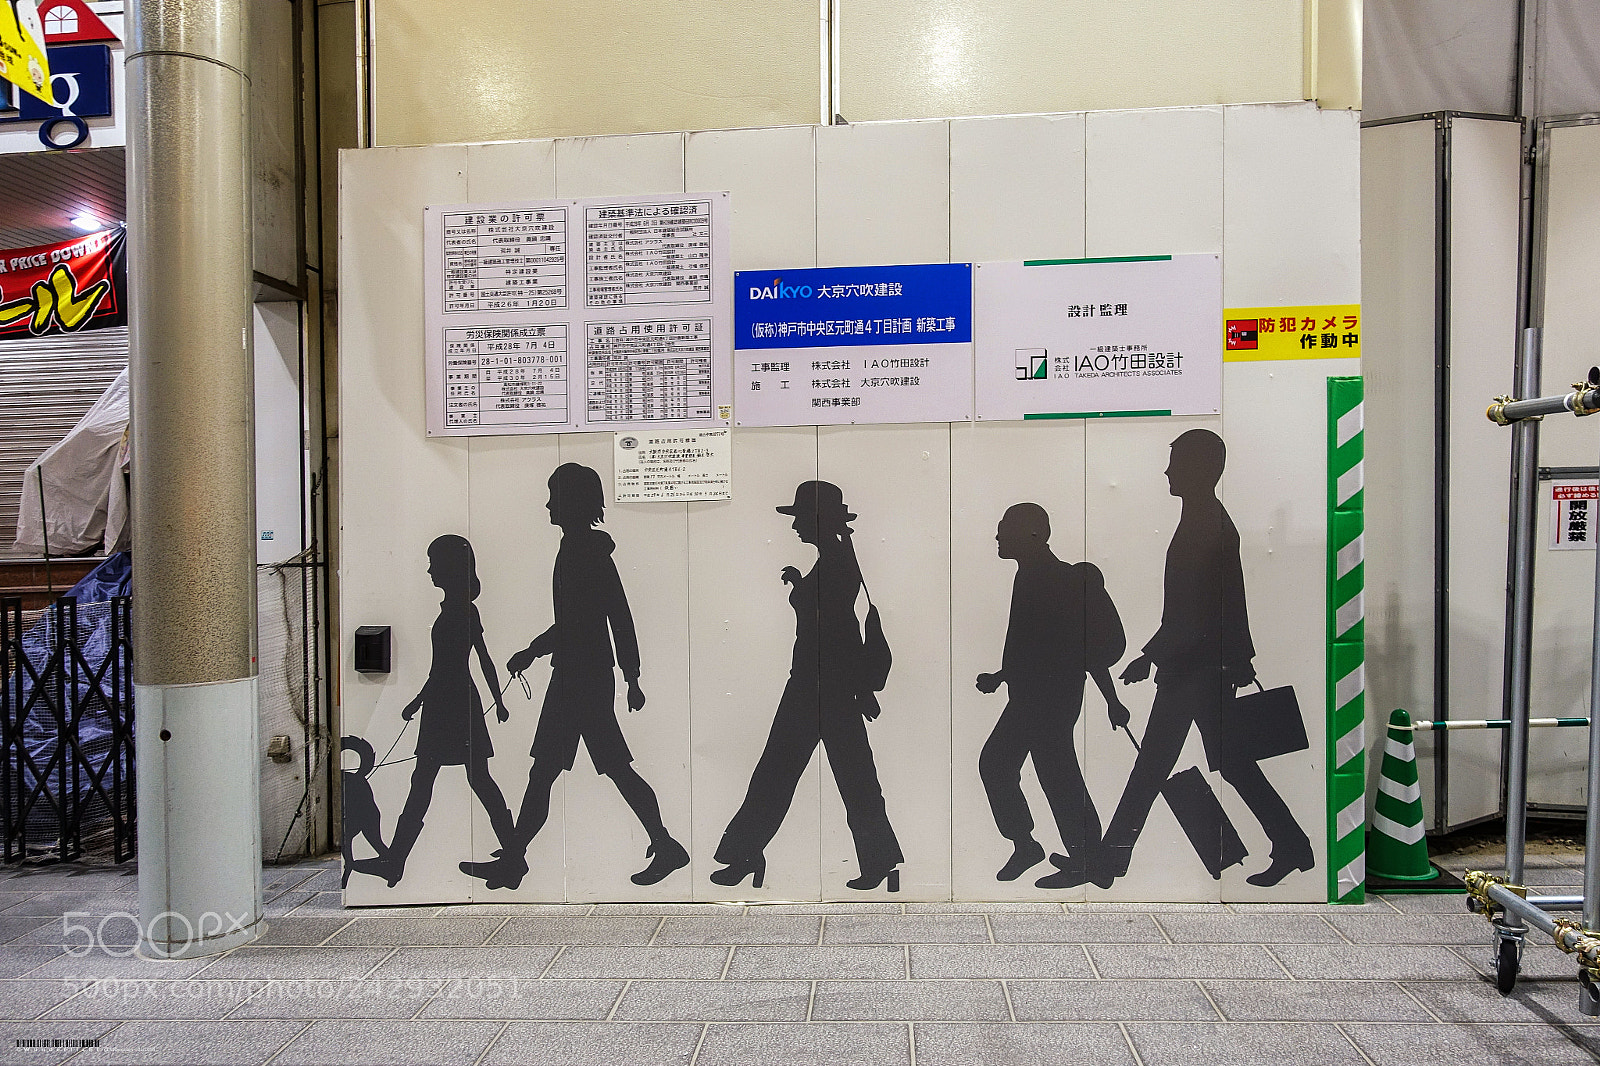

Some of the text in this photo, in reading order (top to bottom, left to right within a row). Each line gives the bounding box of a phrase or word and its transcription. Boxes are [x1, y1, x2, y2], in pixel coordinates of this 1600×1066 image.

[464, 213, 545, 224] 建設業の許可票
[598, 205, 697, 219] 建築基準法による確認済
[10, 252, 48, 271] PRICE
[817, 282, 903, 299] 大京穴吹建設
[1067, 303, 1128, 318] 設計監理
[593, 322, 704, 335] 道路占用使用許可証
[916, 316, 956, 333] 新築工事
[1259, 315, 1358, 333] 防犯カメラ
[466, 327, 546, 339] 労災保険関係成立票
[1300, 332, 1358, 349] 作動中
[1090, 344, 1148, 352] 一級建築士事務所
[481, 355, 563, 365] 28-1-01-803778-001
[751, 357, 930, 372] 工事監理 株式会社 IAO竹田設計
[1075, 351, 1184, 372] IAO竹田設計
[1142, 369, 1183, 377] ASSOCIATES
[811, 378, 851, 389] 株式会社
[860, 376, 920, 388] 大京穴吹建設
[811, 397, 861, 408] 関西事業部
